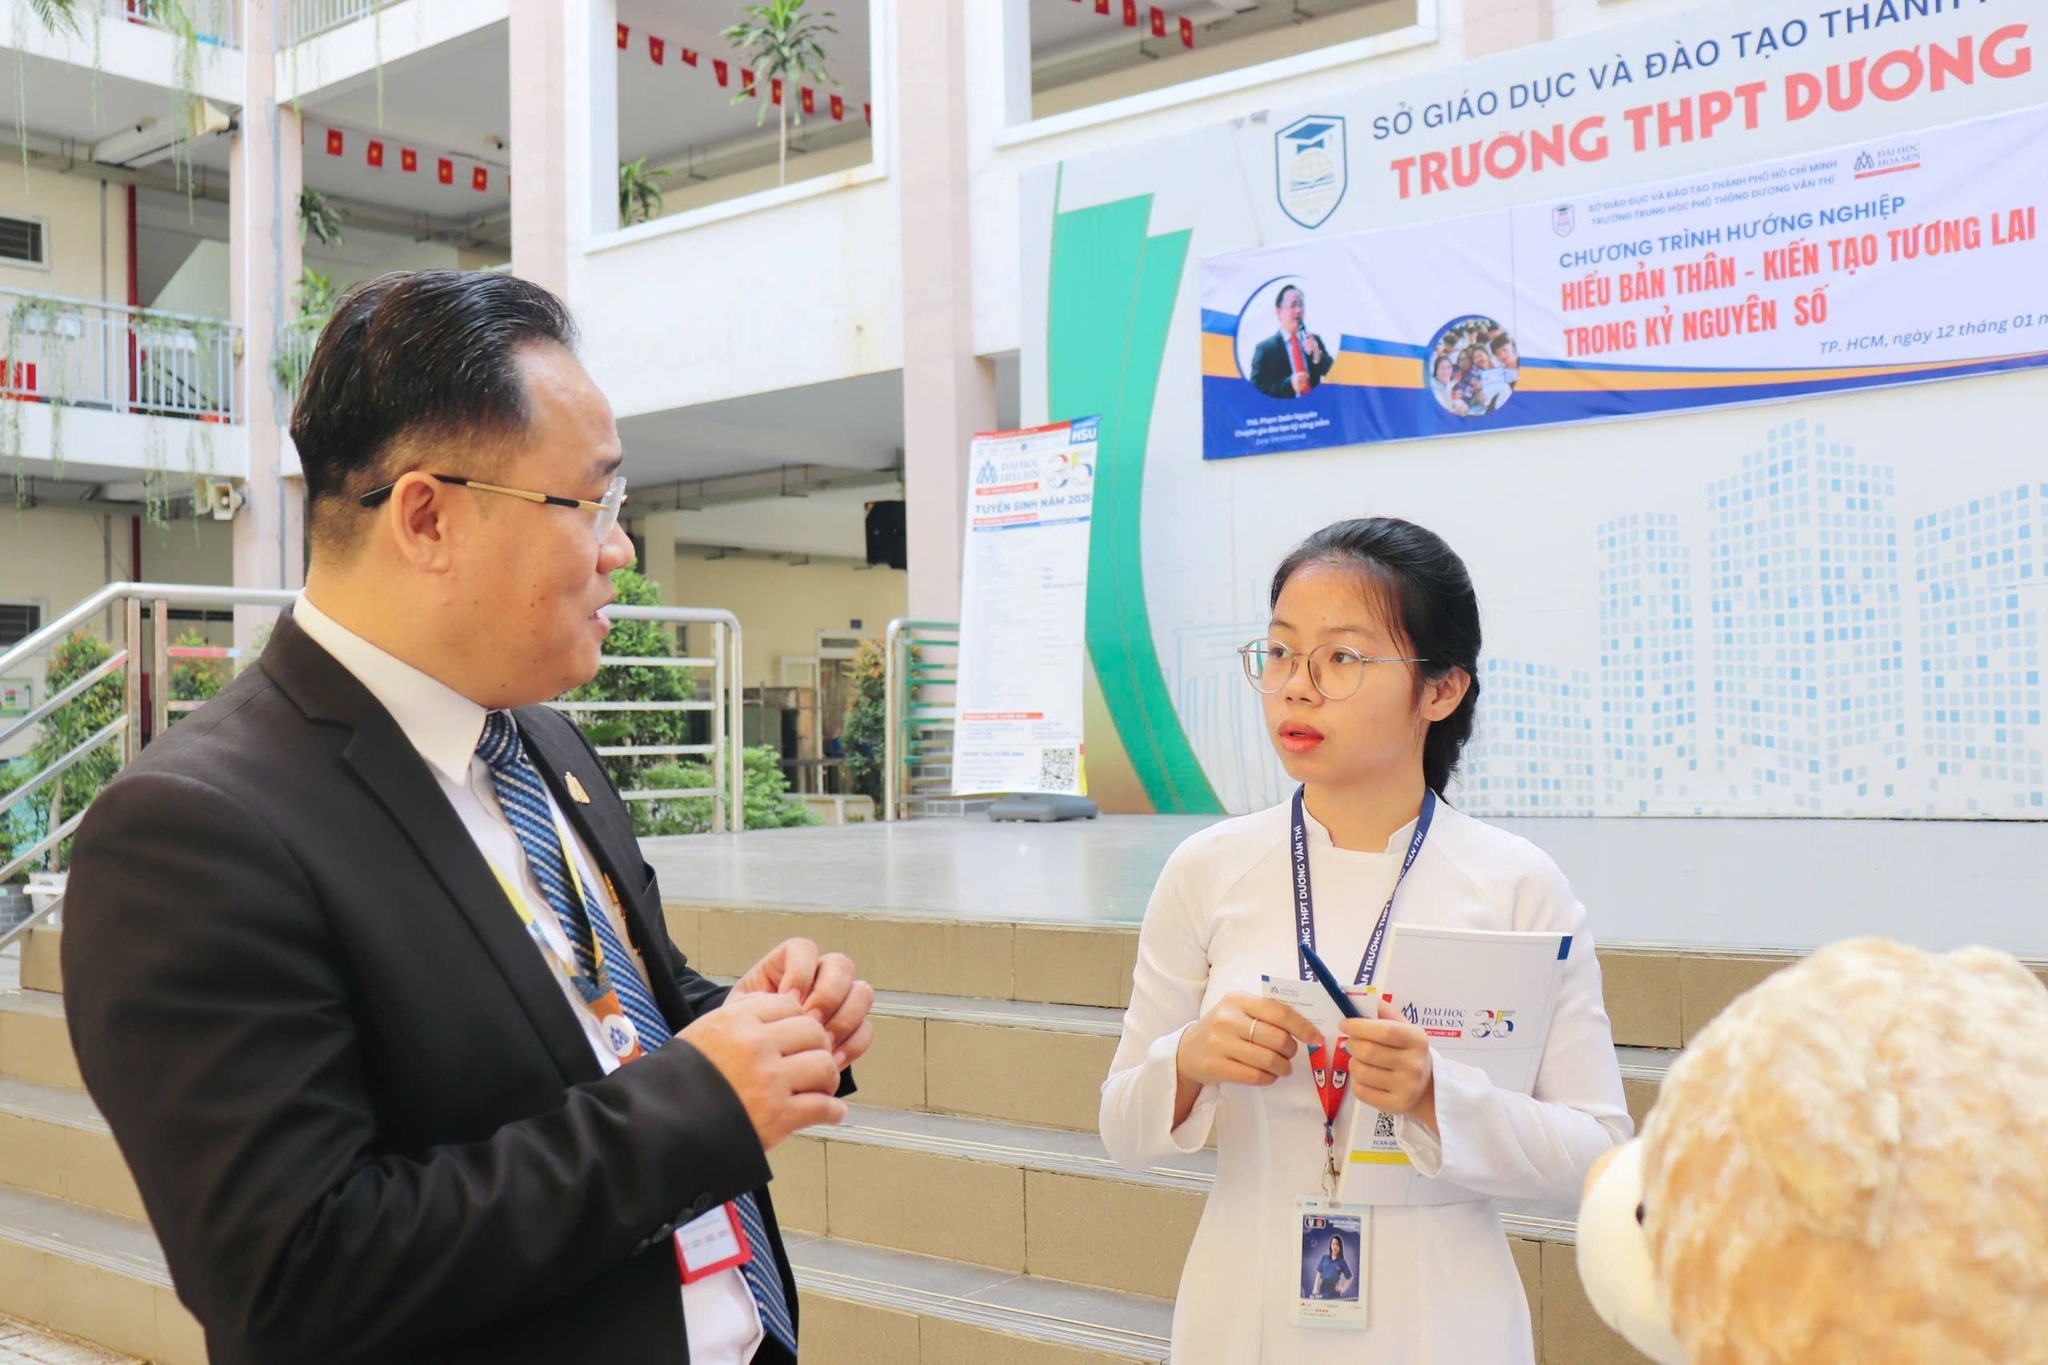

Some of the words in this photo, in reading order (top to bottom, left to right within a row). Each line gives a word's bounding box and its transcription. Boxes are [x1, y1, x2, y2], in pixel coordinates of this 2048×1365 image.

[1373, 101, 1413, 140] SỞ
[1424, 89, 1497, 128] GIÁO
[1510, 73, 1576, 108] DỤC
[1589, 54, 1633, 90] VÀ
[1645, 40, 1720, 79] ĐÀO
[1732, 19, 1808, 59] TẠO
[1390, 116, 1610, 200] TRƯỜNG
[1623, 81, 1766, 152] THPT
[1785, 24, 2031, 122] DƯƠNG
[1809, 160, 1838, 173] MINH
[1634, 207, 1666, 219] TRUNG
[1559, 240, 1653, 268] CHƯƠNG
[1659, 228, 1721, 253] TRÌNH
[1727, 211, 1813, 242] HƯỚNG
[1820, 194, 1906, 225] NGHIỆP
[1561, 269, 1611, 312] HIỂU
[1619, 262, 1665, 303] BẢN
[1673, 252, 1736, 295] THÂN
[1763, 237, 1819, 282] KIẾN
[1828, 234, 1878, 276] TẠO
[1888, 216, 1981, 261] TƯƠNG
[1992, 206, 2036, 246] LAI
[1564, 320, 1637, 358] TRONG
[1645, 304, 1674, 347] KỶ
[1683, 294, 1778, 342] NGUYÊN
[1794, 284, 1831, 326] SỐ
[1820, 341, 1841, 355] TP.
[1846, 335, 1888, 351] HCM,
[1893, 329, 1933, 348] ngày
[1936, 325, 1954, 339] 12
[1959, 317, 2008, 334] tháng
[2013, 314, 2032, 328] 01
[1071, 428, 1098, 442] HSU
[1014, 500, 1038, 511] SINH
[1297, 864, 1308, 900] DƯƠNG
[1300, 901, 1310, 927] THPT
[1421, 1017, 1443, 1027] HOA
[1445, 1018, 1465, 1028] SEN
[1471, 1009, 1516, 1039] 35
